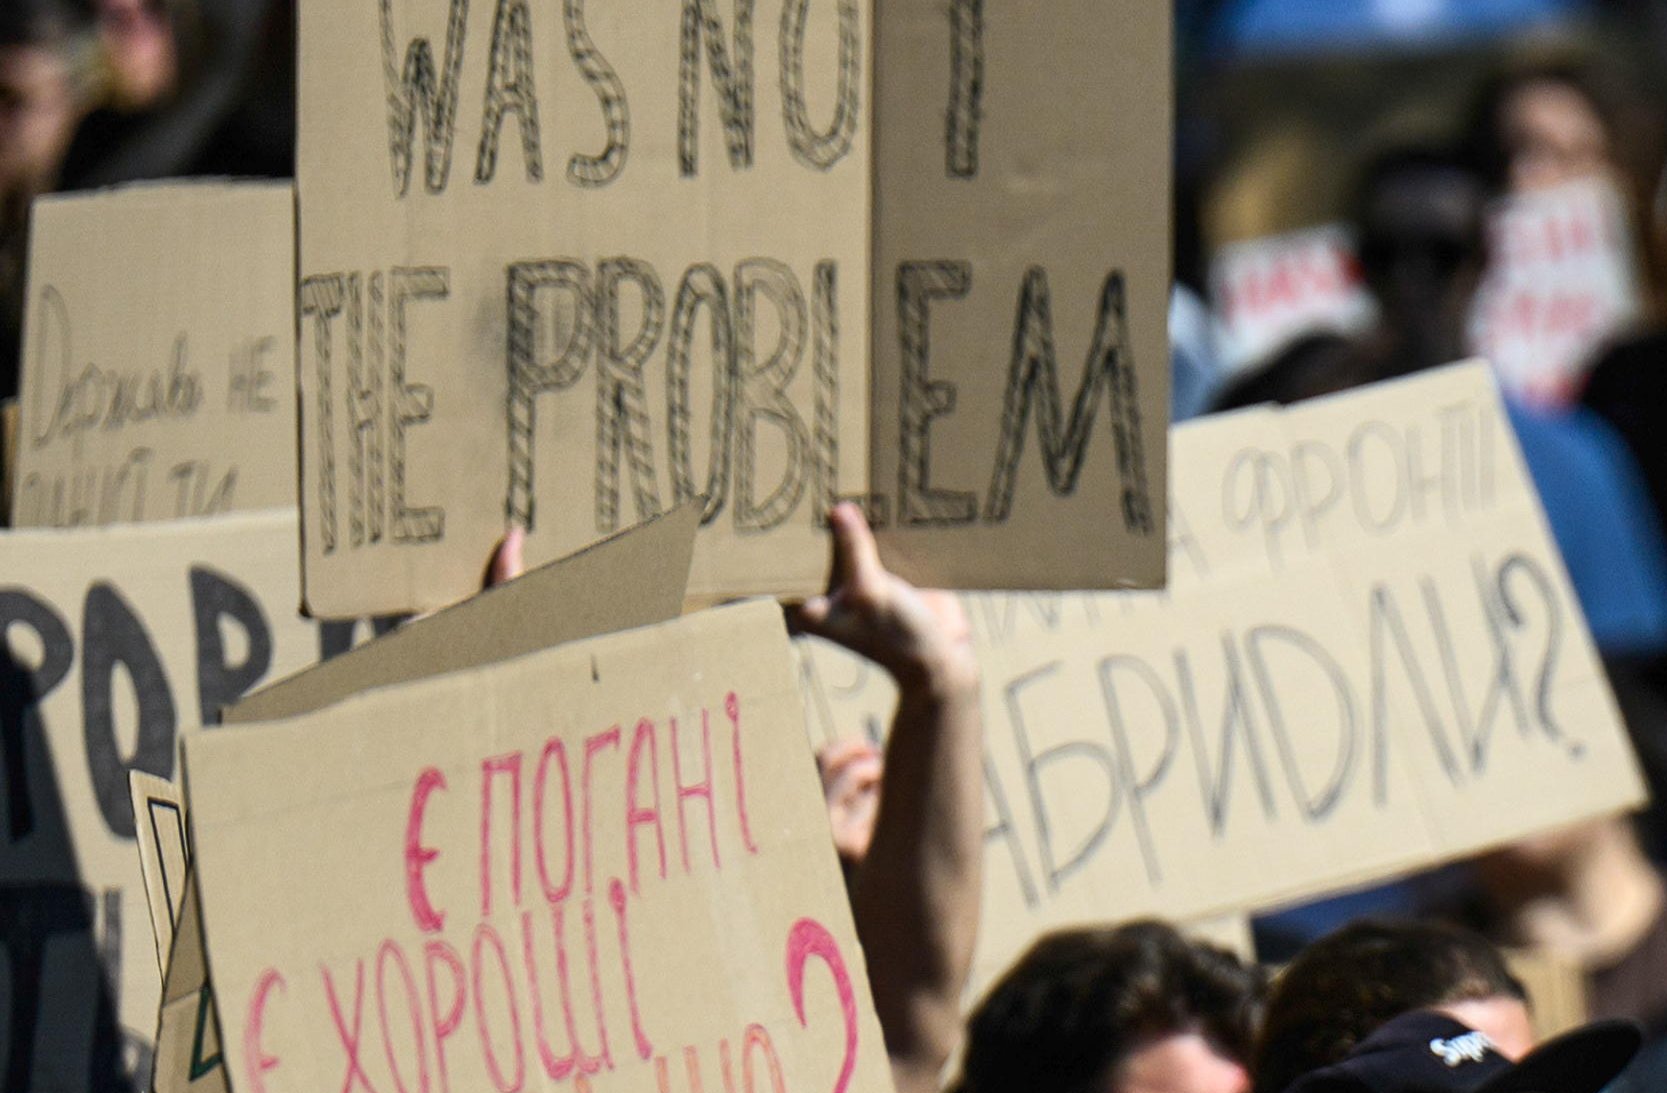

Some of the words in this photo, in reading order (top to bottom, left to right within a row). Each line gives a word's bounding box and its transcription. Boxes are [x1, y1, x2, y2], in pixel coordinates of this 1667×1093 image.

[300, 265, 452, 556] THE
[503, 255, 1153, 536] PROBLEM
[403, 764, 450, 934] Є
[477, 690, 760, 920] ПОГАНІ
